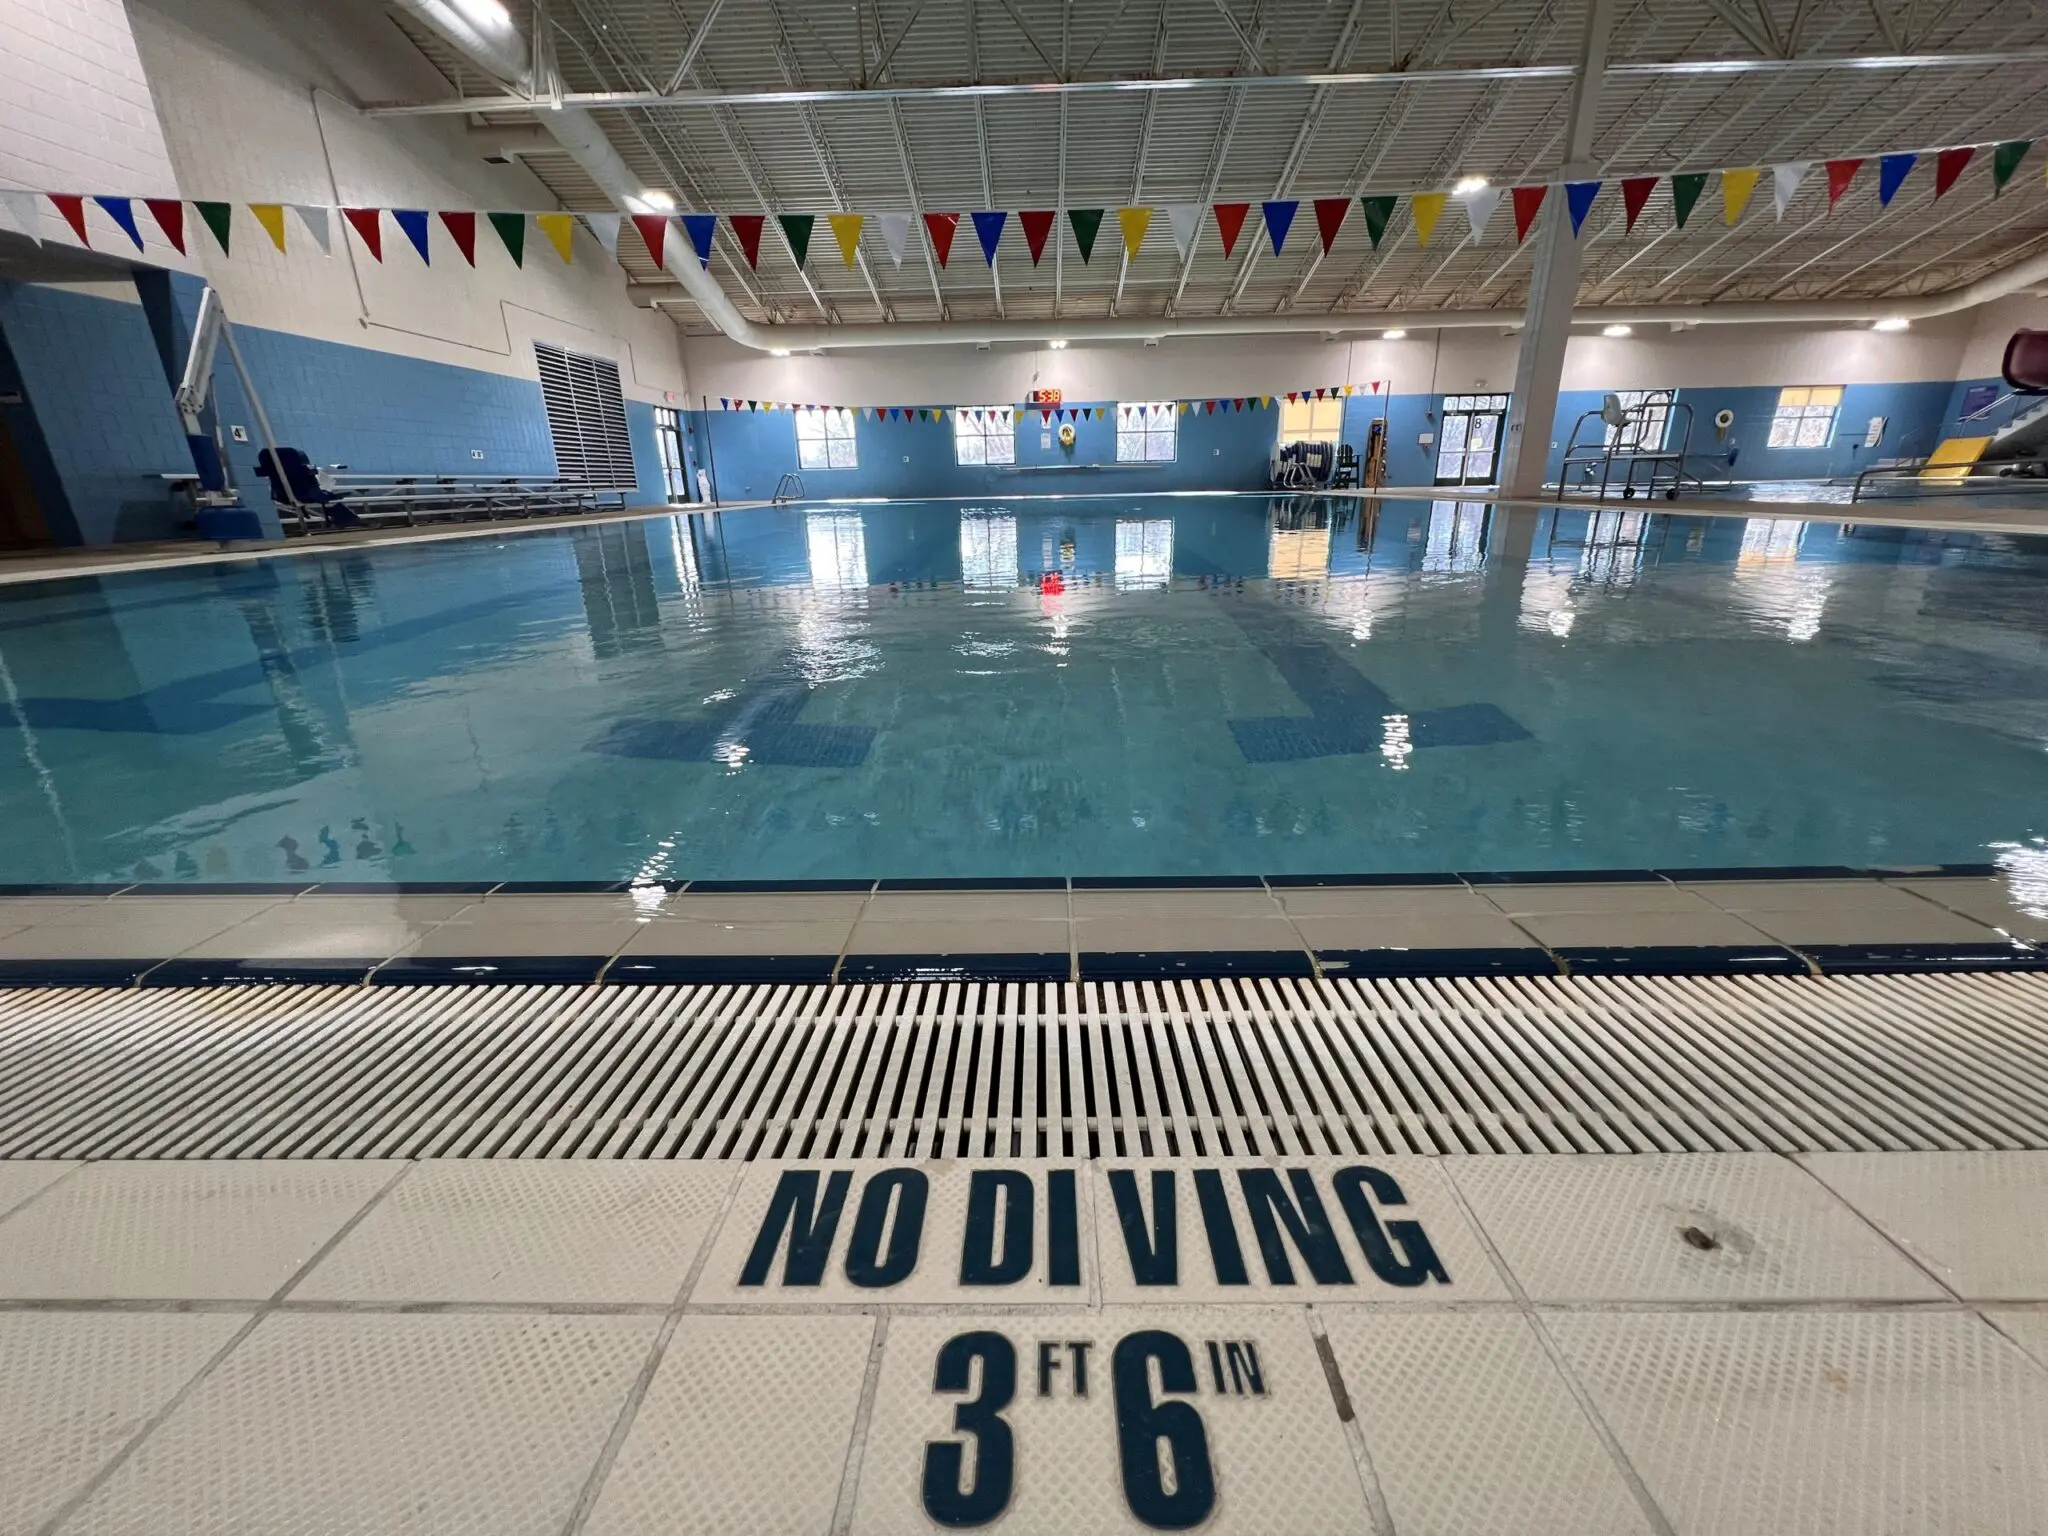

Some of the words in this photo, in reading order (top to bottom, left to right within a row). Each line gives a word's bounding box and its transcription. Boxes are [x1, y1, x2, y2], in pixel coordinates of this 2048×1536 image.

[738, 1167, 929, 1288] NO
[959, 1165, 1452, 1288] DIVING
[921, 1330, 1018, 1529] 3
[1038, 1342, 1092, 1396] FT
[1111, 1329, 1218, 1531] 6
[1206, 1341, 1266, 1395] IN
